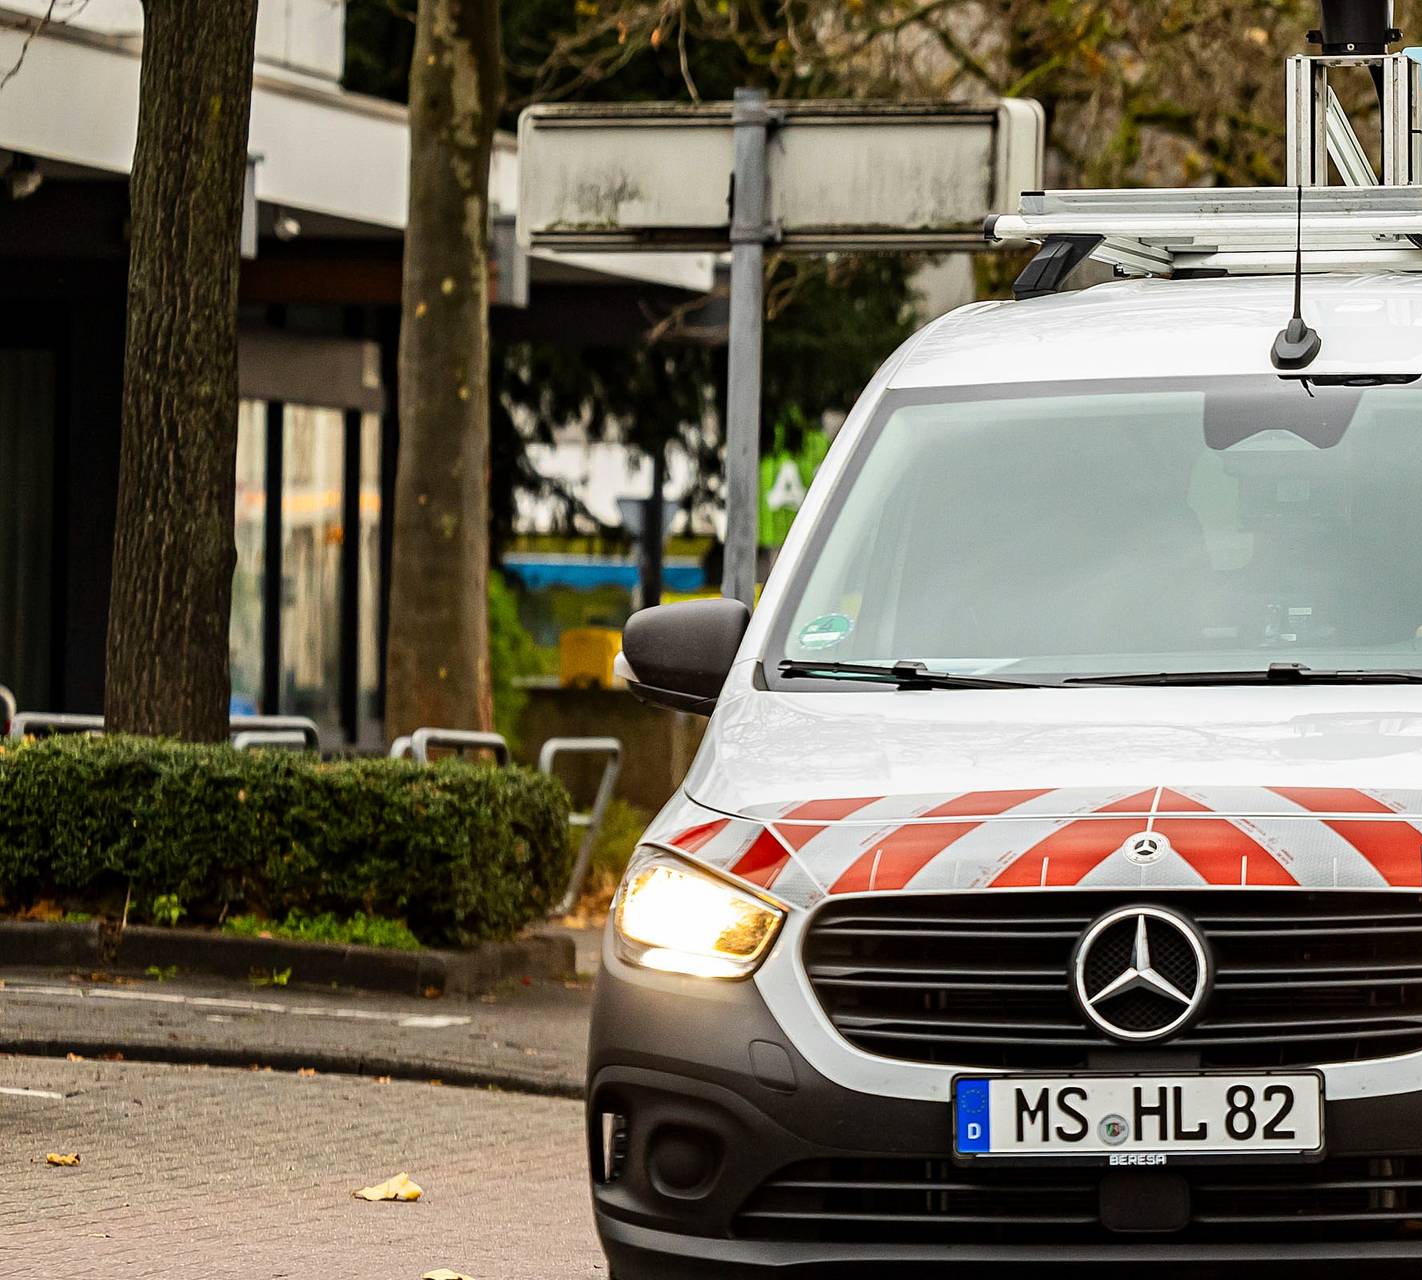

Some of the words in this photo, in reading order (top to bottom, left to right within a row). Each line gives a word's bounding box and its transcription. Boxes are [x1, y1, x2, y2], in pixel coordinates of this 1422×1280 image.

[967, 1123, 981, 1139] D
[1015, 1086, 1089, 1143] MS
[1133, 1086, 1208, 1142] HL
[1225, 1084, 1296, 1141] 82
[1109, 1153, 1167, 1166] BERESA
